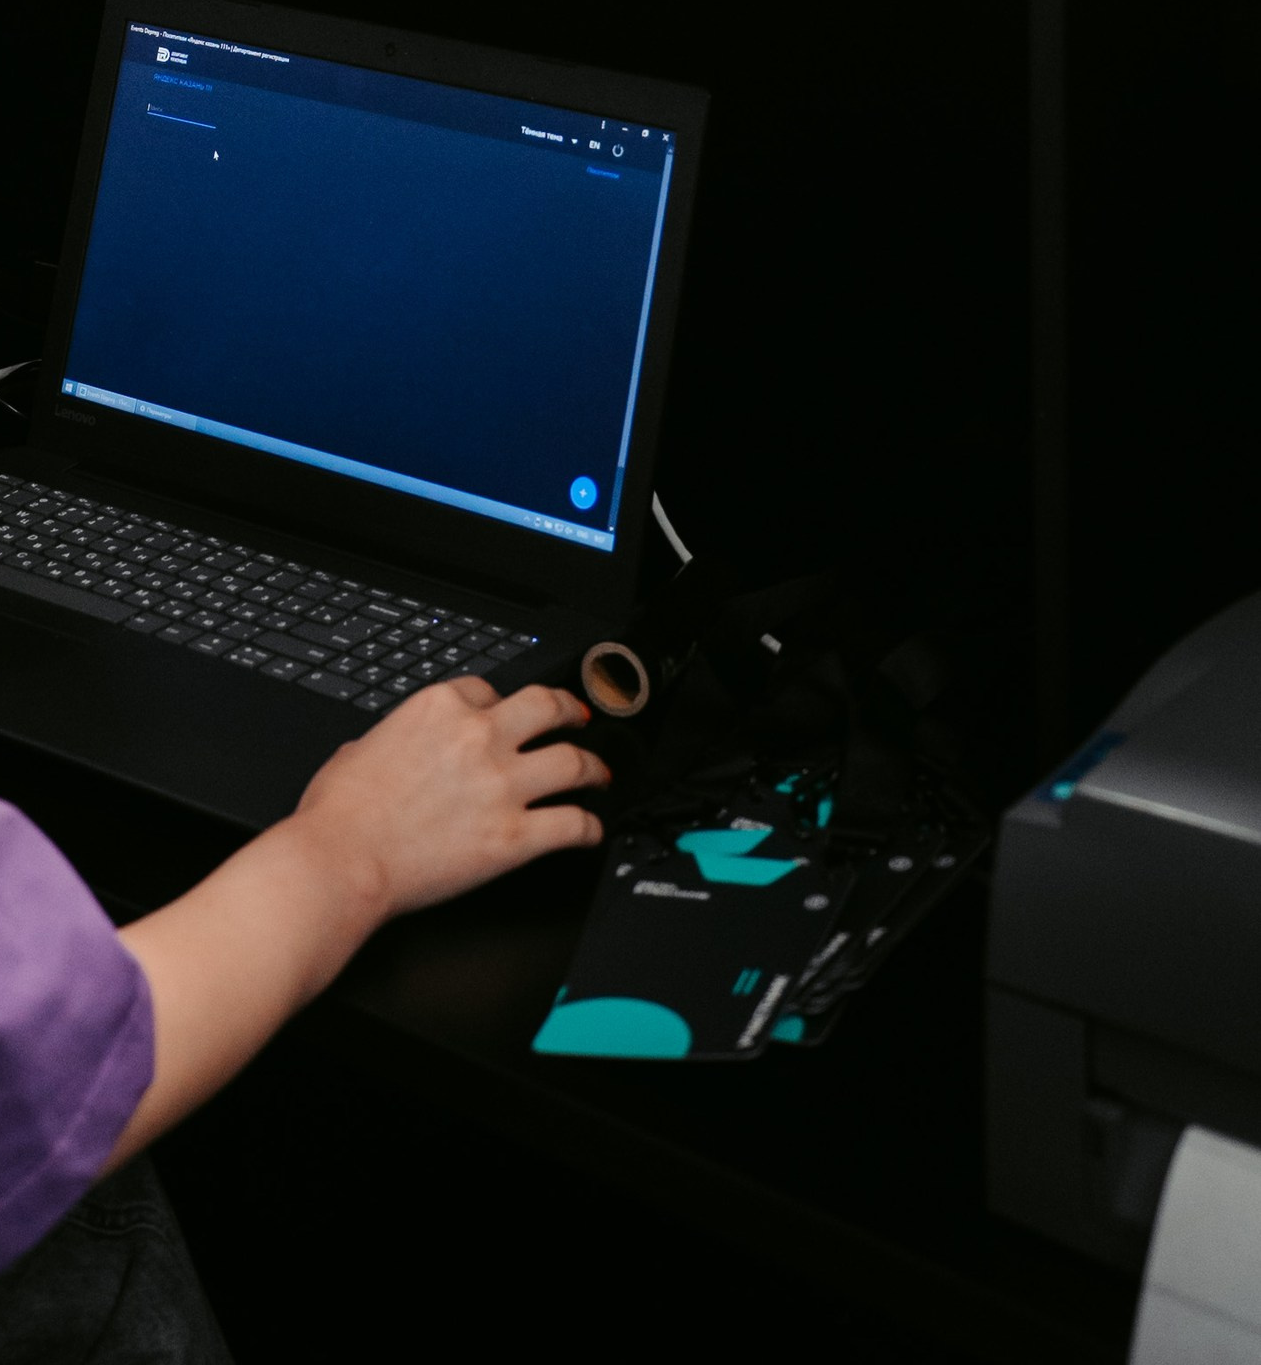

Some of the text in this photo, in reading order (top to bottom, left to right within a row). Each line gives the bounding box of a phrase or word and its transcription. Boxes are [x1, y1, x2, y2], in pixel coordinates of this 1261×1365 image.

[546, 132, 564, 142] тема
[588, 140, 601, 150] EN
[54, 403, 97, 427] Lenovo
